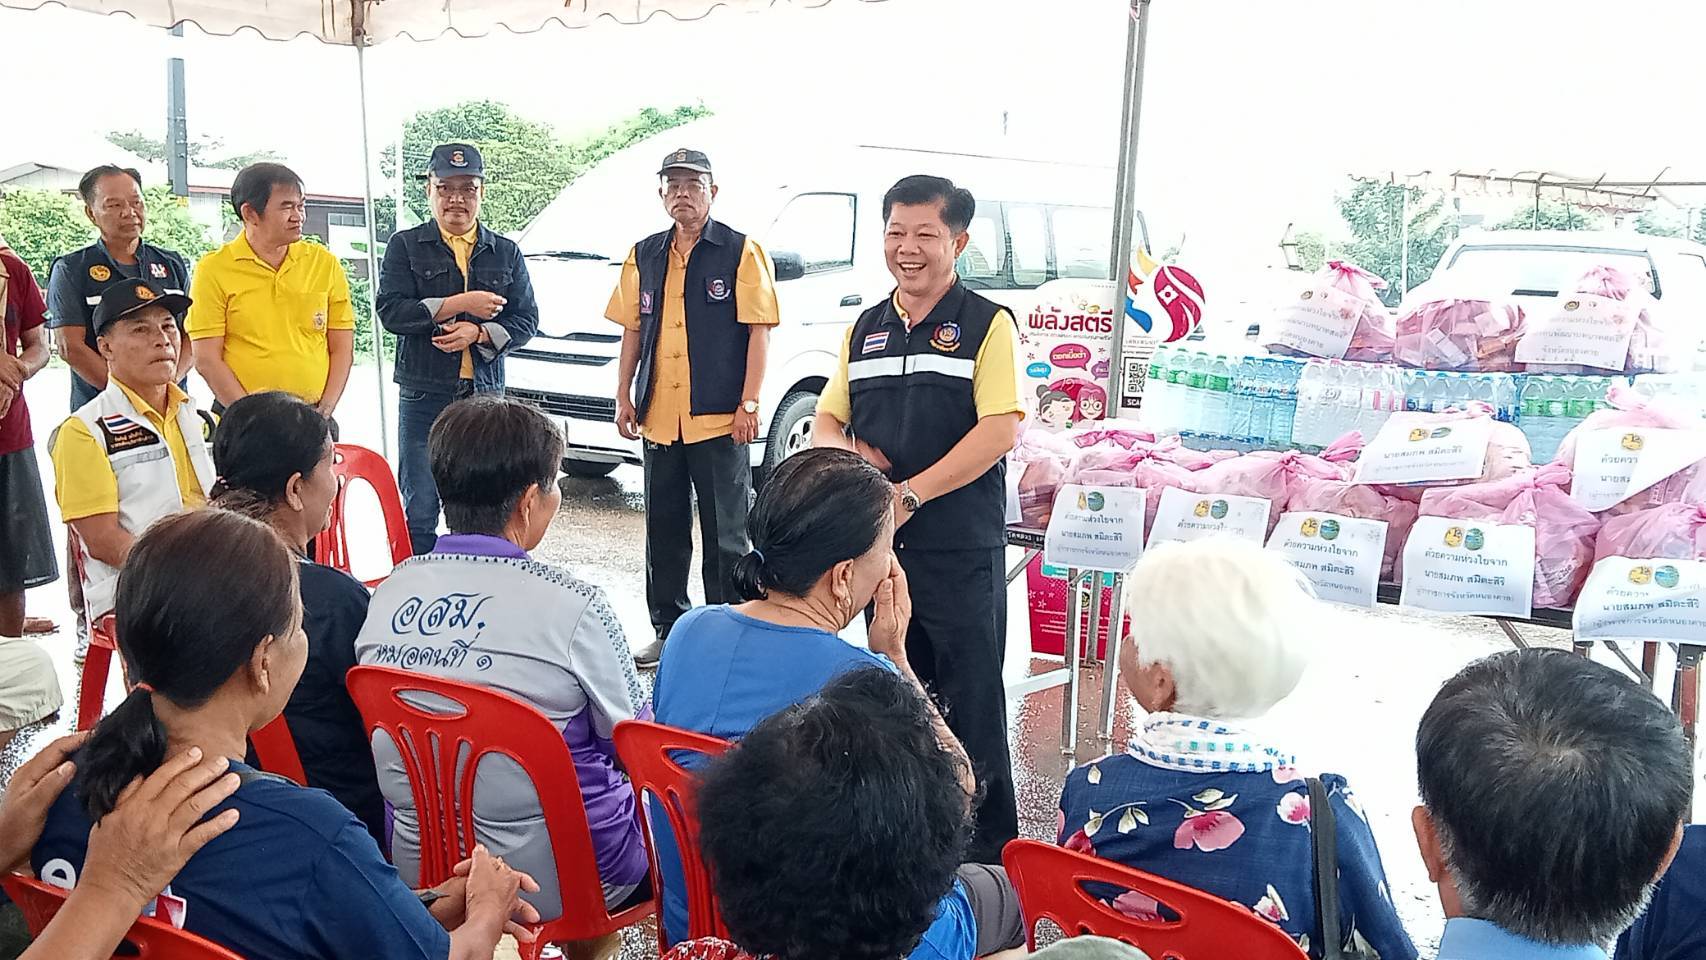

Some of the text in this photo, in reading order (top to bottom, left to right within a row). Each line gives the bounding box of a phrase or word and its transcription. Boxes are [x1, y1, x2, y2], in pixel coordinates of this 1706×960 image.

[391, 592, 494, 636] อสม.
[375, 632, 481, 670] หมอคนที่
